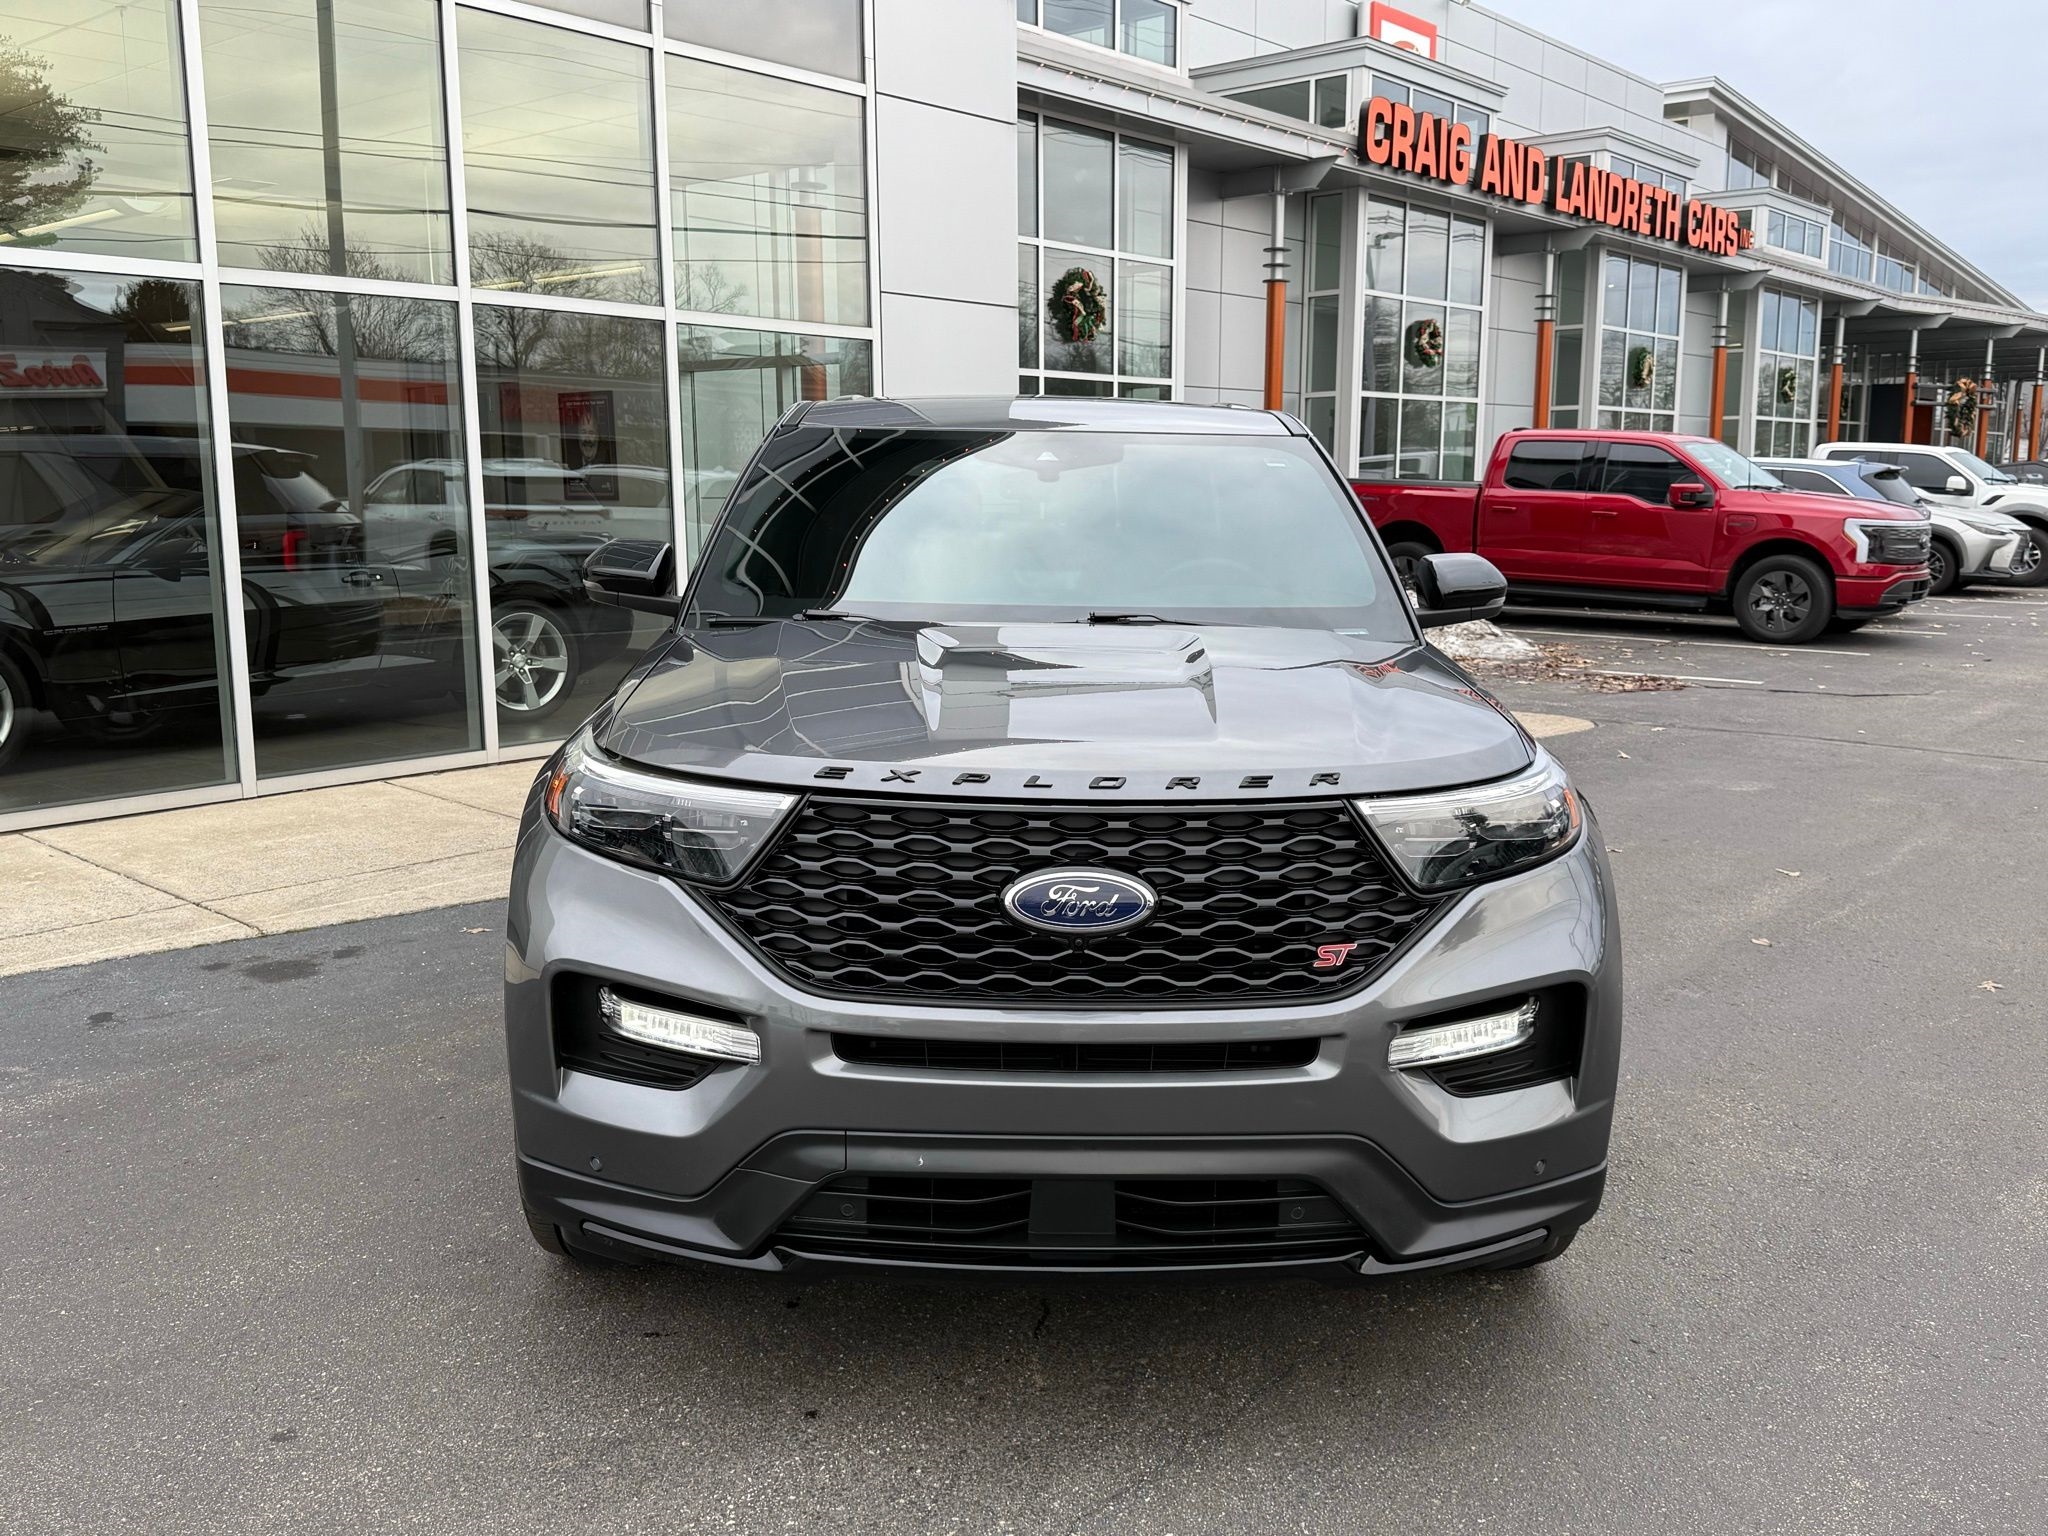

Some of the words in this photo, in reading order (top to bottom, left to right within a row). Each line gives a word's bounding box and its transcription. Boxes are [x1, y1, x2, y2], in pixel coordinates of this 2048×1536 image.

[1364, 95, 1472, 186] CRAIG
[1480, 133, 1546, 206] AND
[1554, 154, 1682, 242] LANDRETH
[1686, 199, 1739, 257] CARS
[813, 765, 1342, 791] EXPLORER
[1041, 884, 1120, 918] Ford
[1313, 943, 1358, 967] ST
